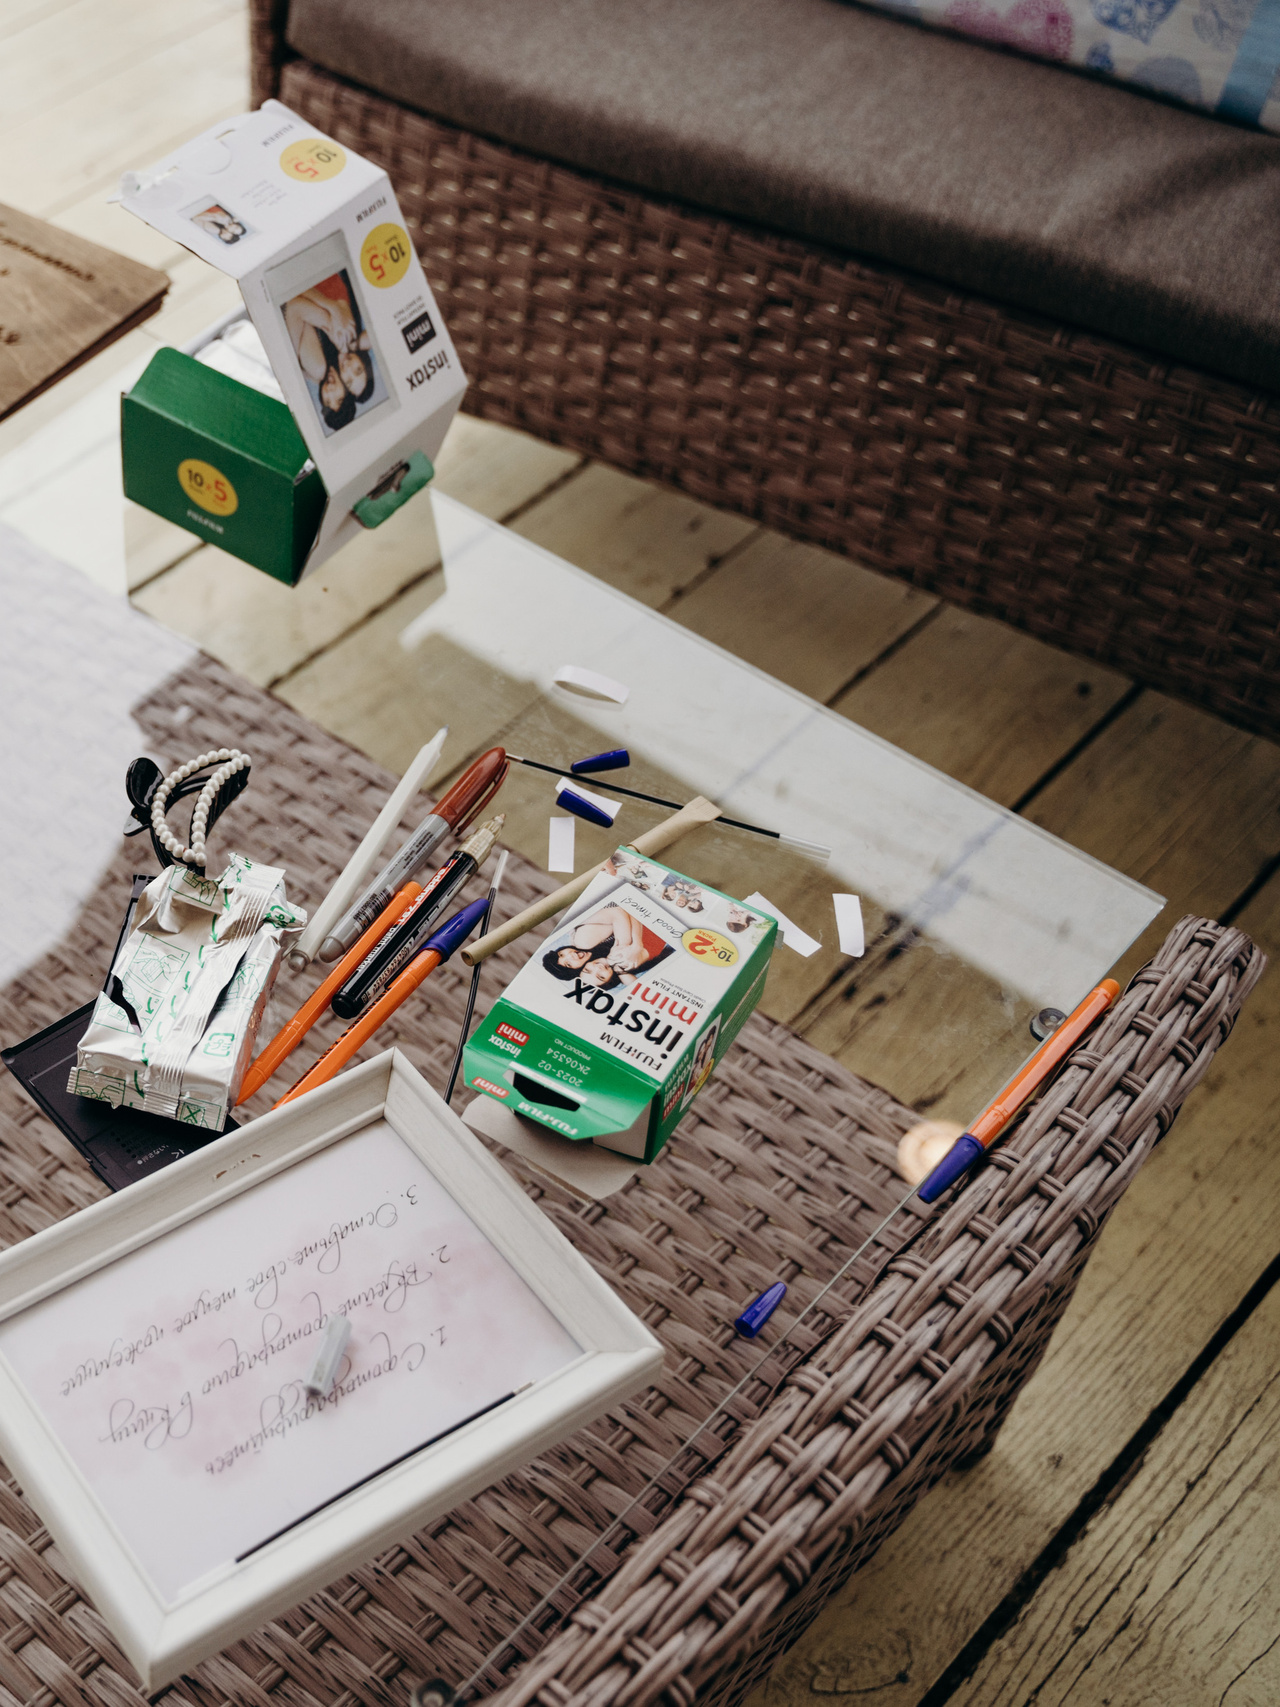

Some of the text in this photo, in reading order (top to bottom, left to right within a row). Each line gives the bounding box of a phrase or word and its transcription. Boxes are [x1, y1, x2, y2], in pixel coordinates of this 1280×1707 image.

[318, 148, 338, 165] 10
[294, 162, 319, 179] 5
[357, 197, 387, 223] FUJIFILM
[369, 255, 386, 280] 5
[388, 245, 406, 265] 10
[405, 320, 431, 348] mini
[406, 350, 451, 391] instax
[187, 469, 204, 487] 10
[214, 479, 228, 502] 5
[414, 867, 446, 904] edding
[396, 904, 416, 926] 791
[620, 896, 684, 939] Good times!
[377, 925, 397, 950] paint
[687, 933, 710, 955] 2
[697, 929, 716, 942] Packs
[355, 946, 380, 974] marker
[717, 951, 732, 963] 10
[630, 982, 697, 1024] mini
[652, 980, 704, 1009] INSTANT FILM
[563, 977, 684, 1054] instax
[488, 1034, 522, 1057] instax
[500, 1024, 527, 1045] mini
[546, 1047, 591, 1075] 2K06354
[554, 1038, 591, 1061] PRODUCT NO
[599, 1032, 662, 1071] FUJIFILM
[537, 1060, 582, 1087] 2023-02
[475, 1078, 508, 1097] mini
[517, 1101, 577, 1136] FUJIFILM
[58, 1183, 419, 1398] 3. Оставьте свое теплое пожелание
[97, 1244, 451, 1450] 2. Вклейте фотографию в книгу
[204, 1324, 448, 1477] 1. Сфотографируйтесь
